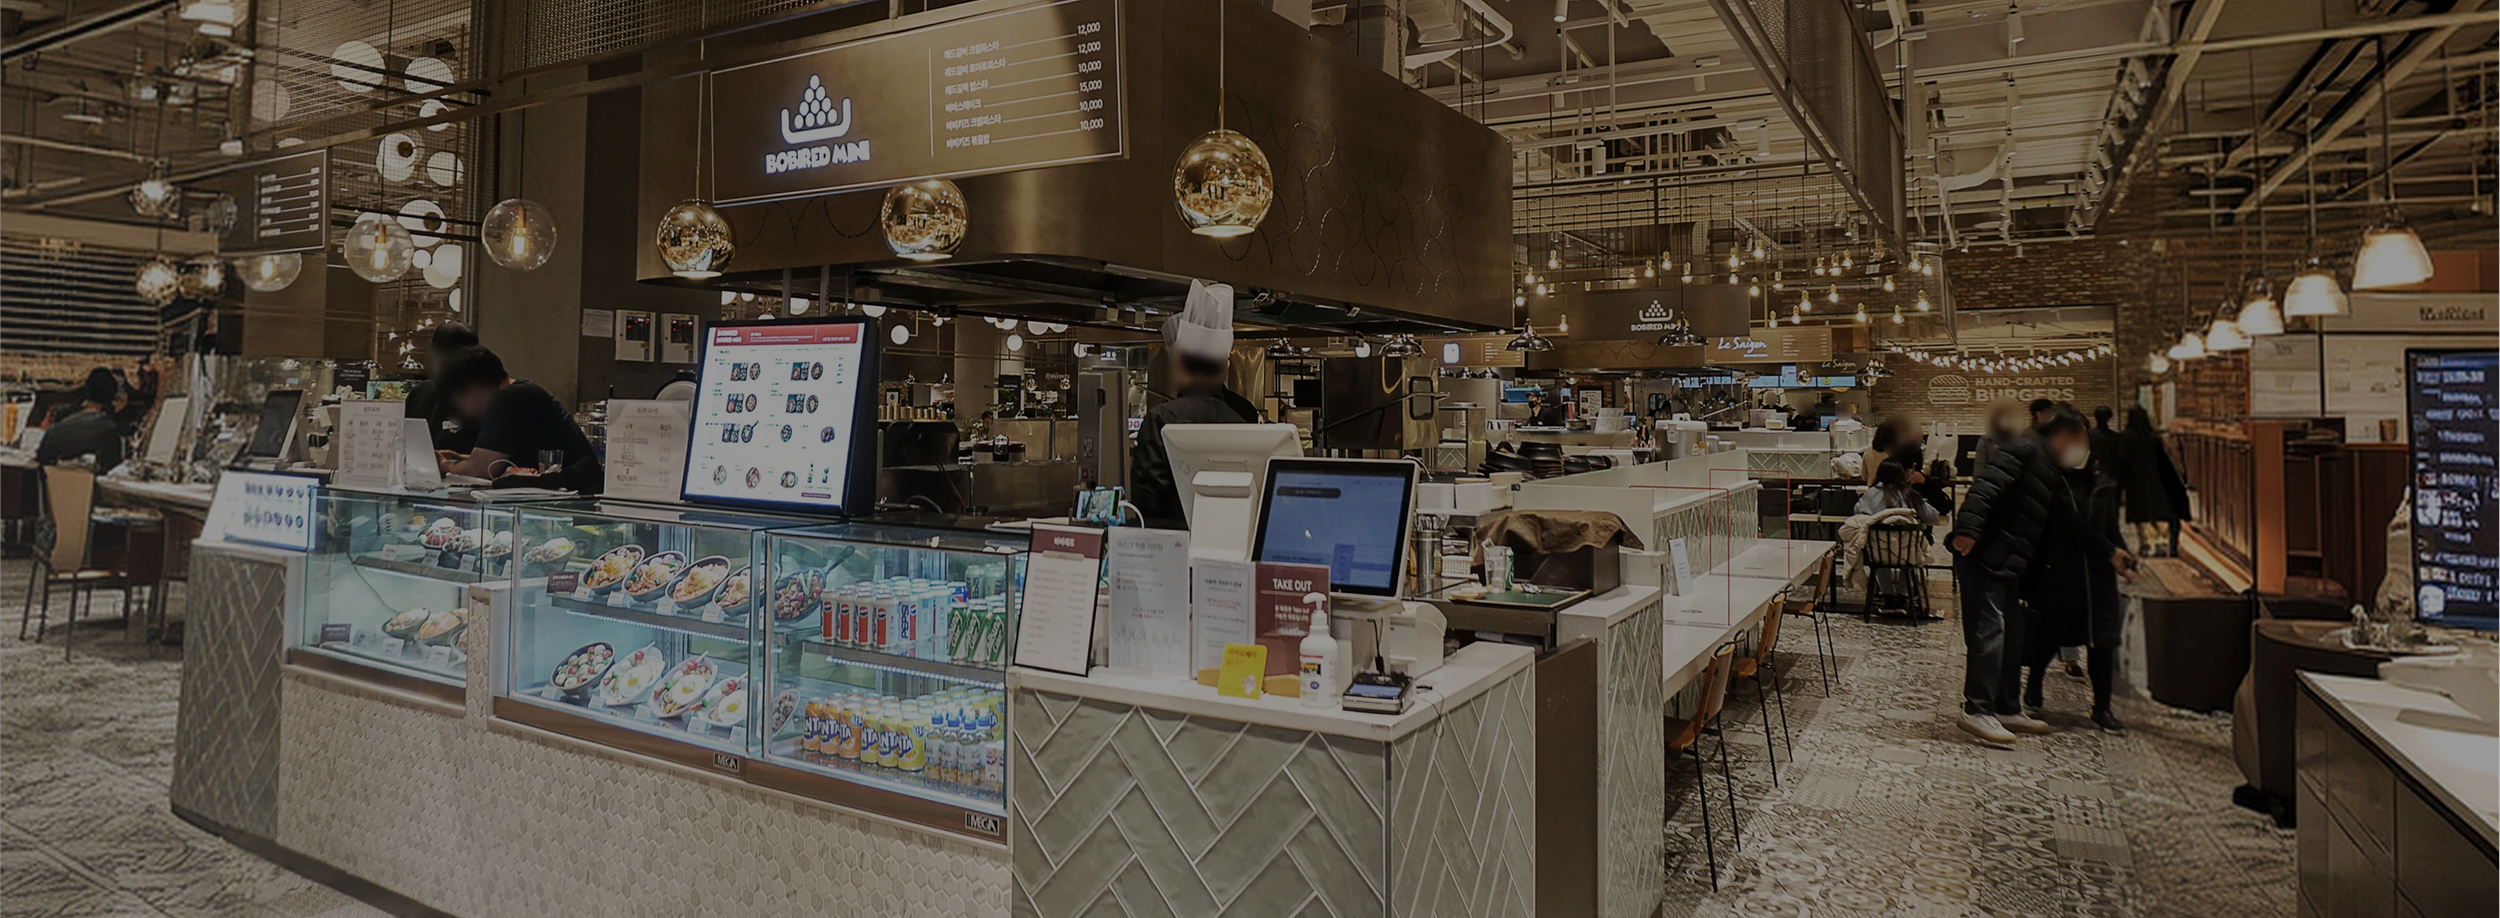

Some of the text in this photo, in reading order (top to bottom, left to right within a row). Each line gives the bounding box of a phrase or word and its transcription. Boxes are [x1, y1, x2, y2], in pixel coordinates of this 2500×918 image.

[1077, 21, 1100, 35] 12,000
[1077, 40, 1101, 54] 12,000
[1078, 60, 1101, 73] 10,000
[1079, 79, 1102, 93] 15,000
[1079, 98, 1103, 112] 10,000
[1080, 118, 1103, 131] 10,000
[765, 139, 871, 174] BOBIRED MINI
[1630, 323, 1663, 332] BOBIRED
[1717, 337, 1731, 350] Le
[1732, 337, 1768, 353] Saigon
[1821, 358, 1857, 370] Le Saigon
[1975, 377, 2075, 386] HAND-CRAFTED
[1975, 388, 2075, 402] BURGERS
[1272, 578, 1313, 592] TAKE OUT
[971, 814, 996, 832] MEGA
